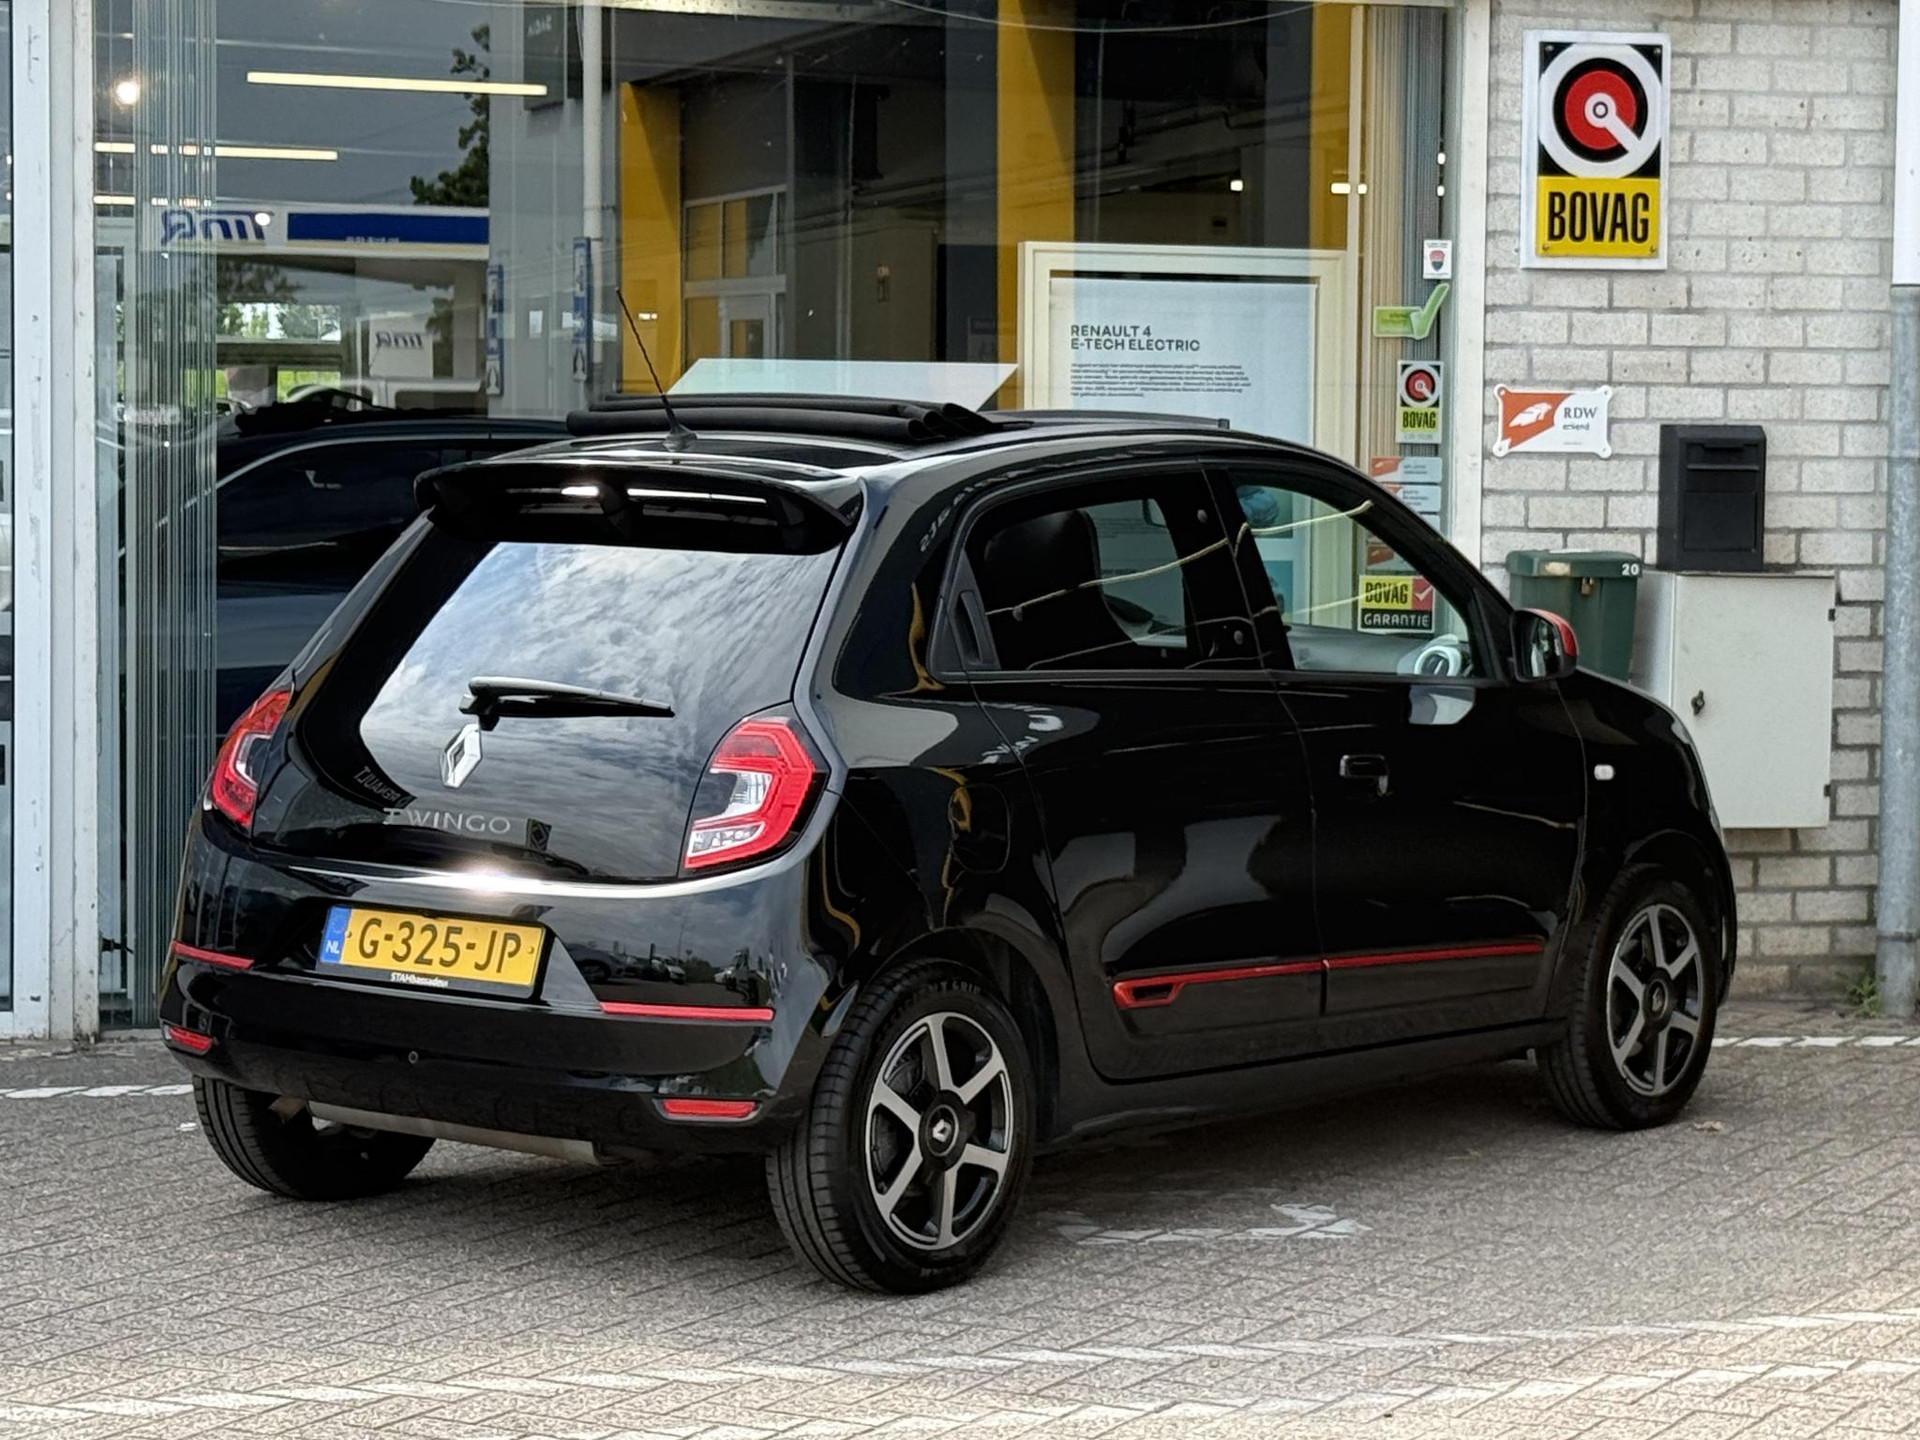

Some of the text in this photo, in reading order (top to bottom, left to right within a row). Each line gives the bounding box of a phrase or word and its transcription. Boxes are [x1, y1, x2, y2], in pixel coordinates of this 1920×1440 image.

[1548, 191, 1650, 243] BOVAG
[1070, 324, 1151, 337] RENAULT 4
[1070, 338, 1201, 351] E-TECH ELECTRIC
[1402, 411, 1437, 429] BOVAG
[1563, 407, 1597, 419] RDW
[1621, 562, 1640, 576] 20
[1365, 582, 1409, 604] BOVAG
[1364, 612, 1429, 628] GARANTIE
[382, 807, 511, 834] TWINGO
[325, 917, 522, 974] NL G-325-JP
